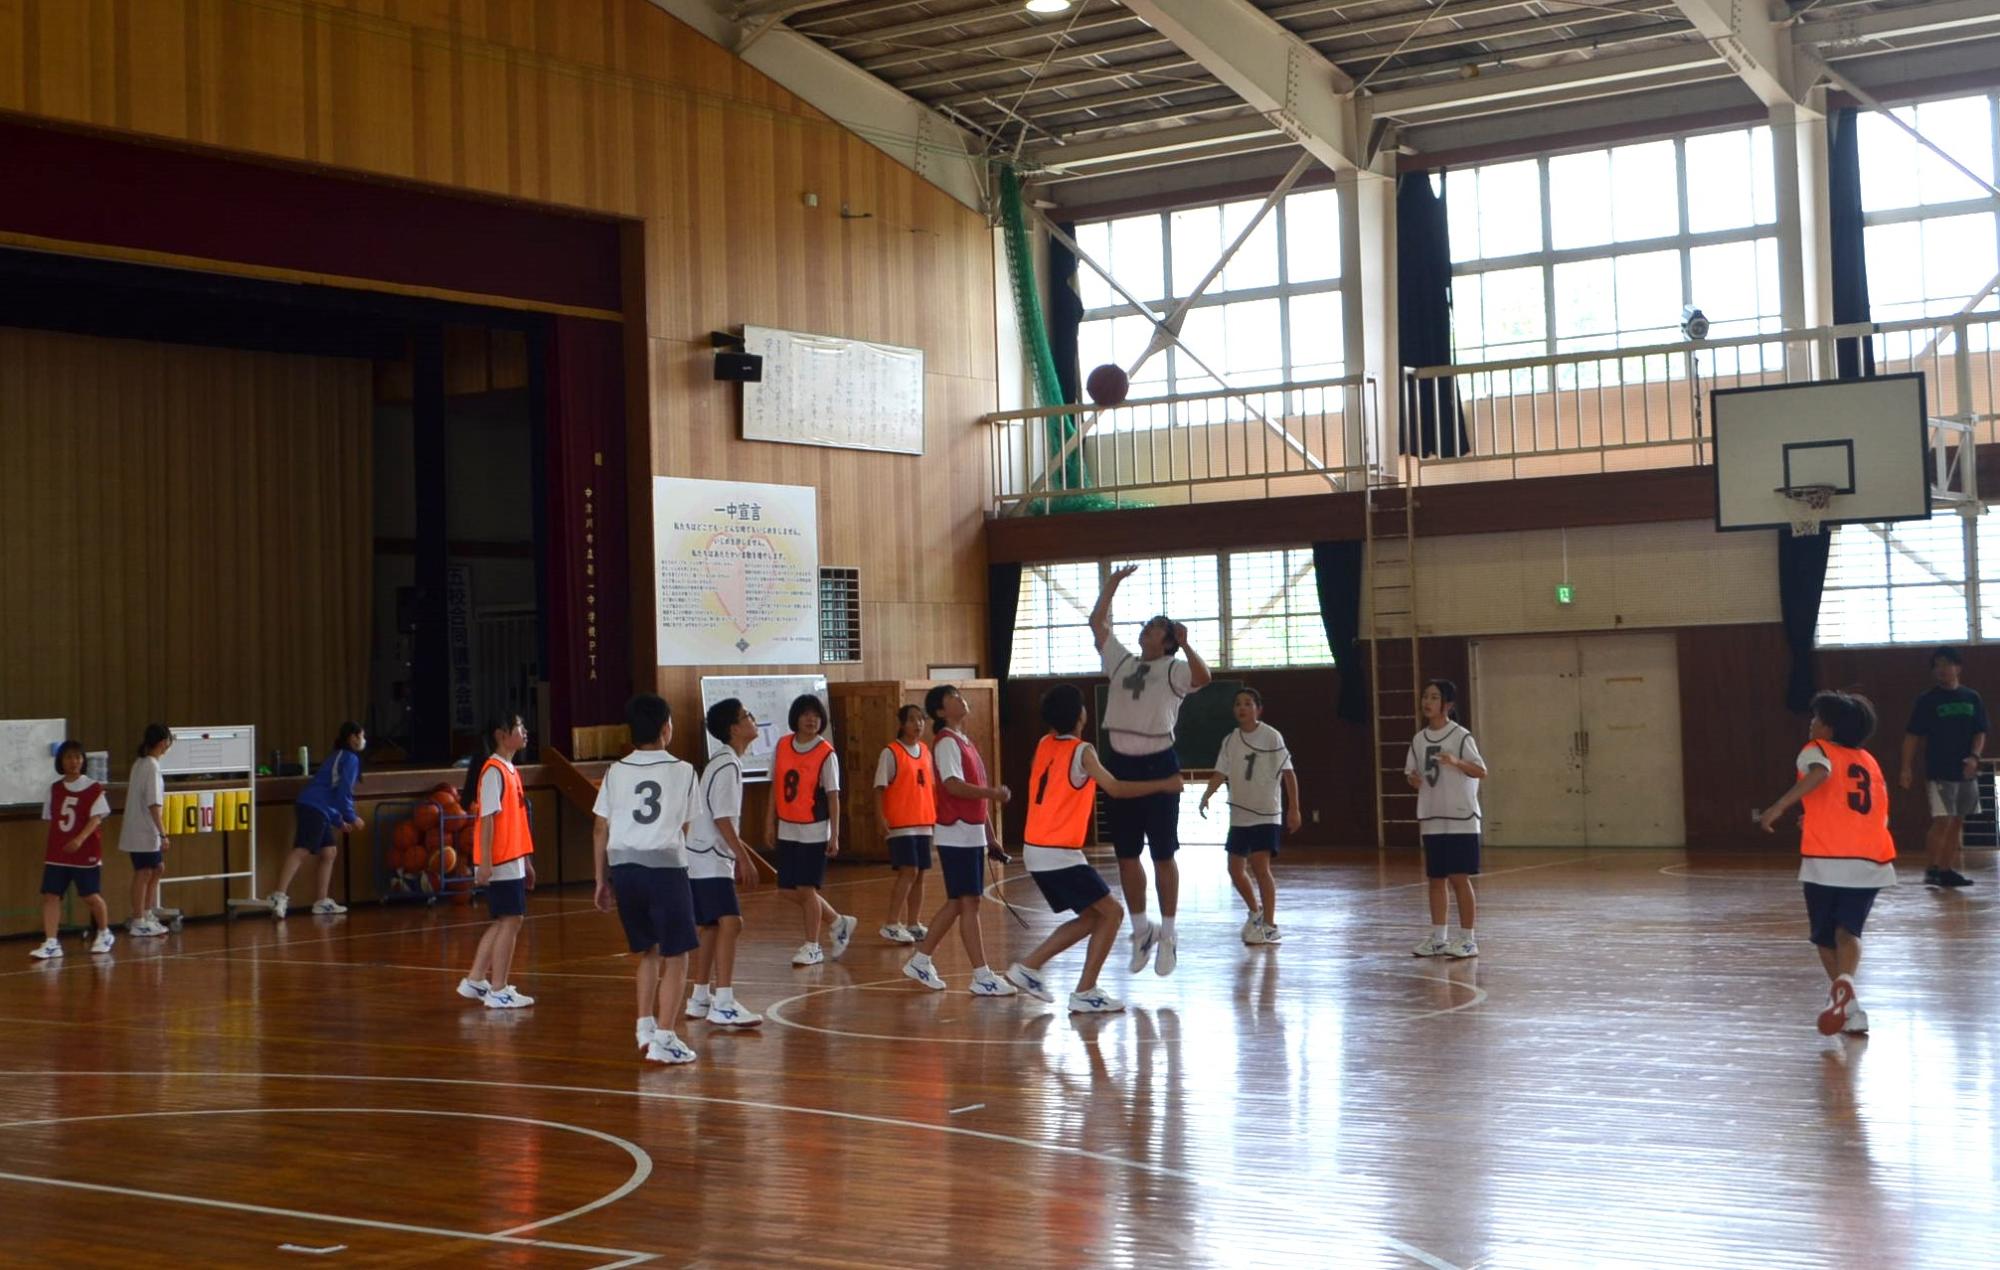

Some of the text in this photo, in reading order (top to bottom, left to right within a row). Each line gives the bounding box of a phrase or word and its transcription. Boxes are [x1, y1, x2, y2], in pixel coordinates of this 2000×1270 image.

[714, 502, 762, 521] 一中宣言
[1122, 664, 1151, 700] 4
[1425, 745, 1441, 788] 5
[632, 780, 662, 824] 3
[784, 769, 800, 803] 8
[1847, 763, 1872, 815] 3
[59, 796, 79, 832] 5
[186, 806, 197, 827] 0
[239, 803, 249, 824] 0
